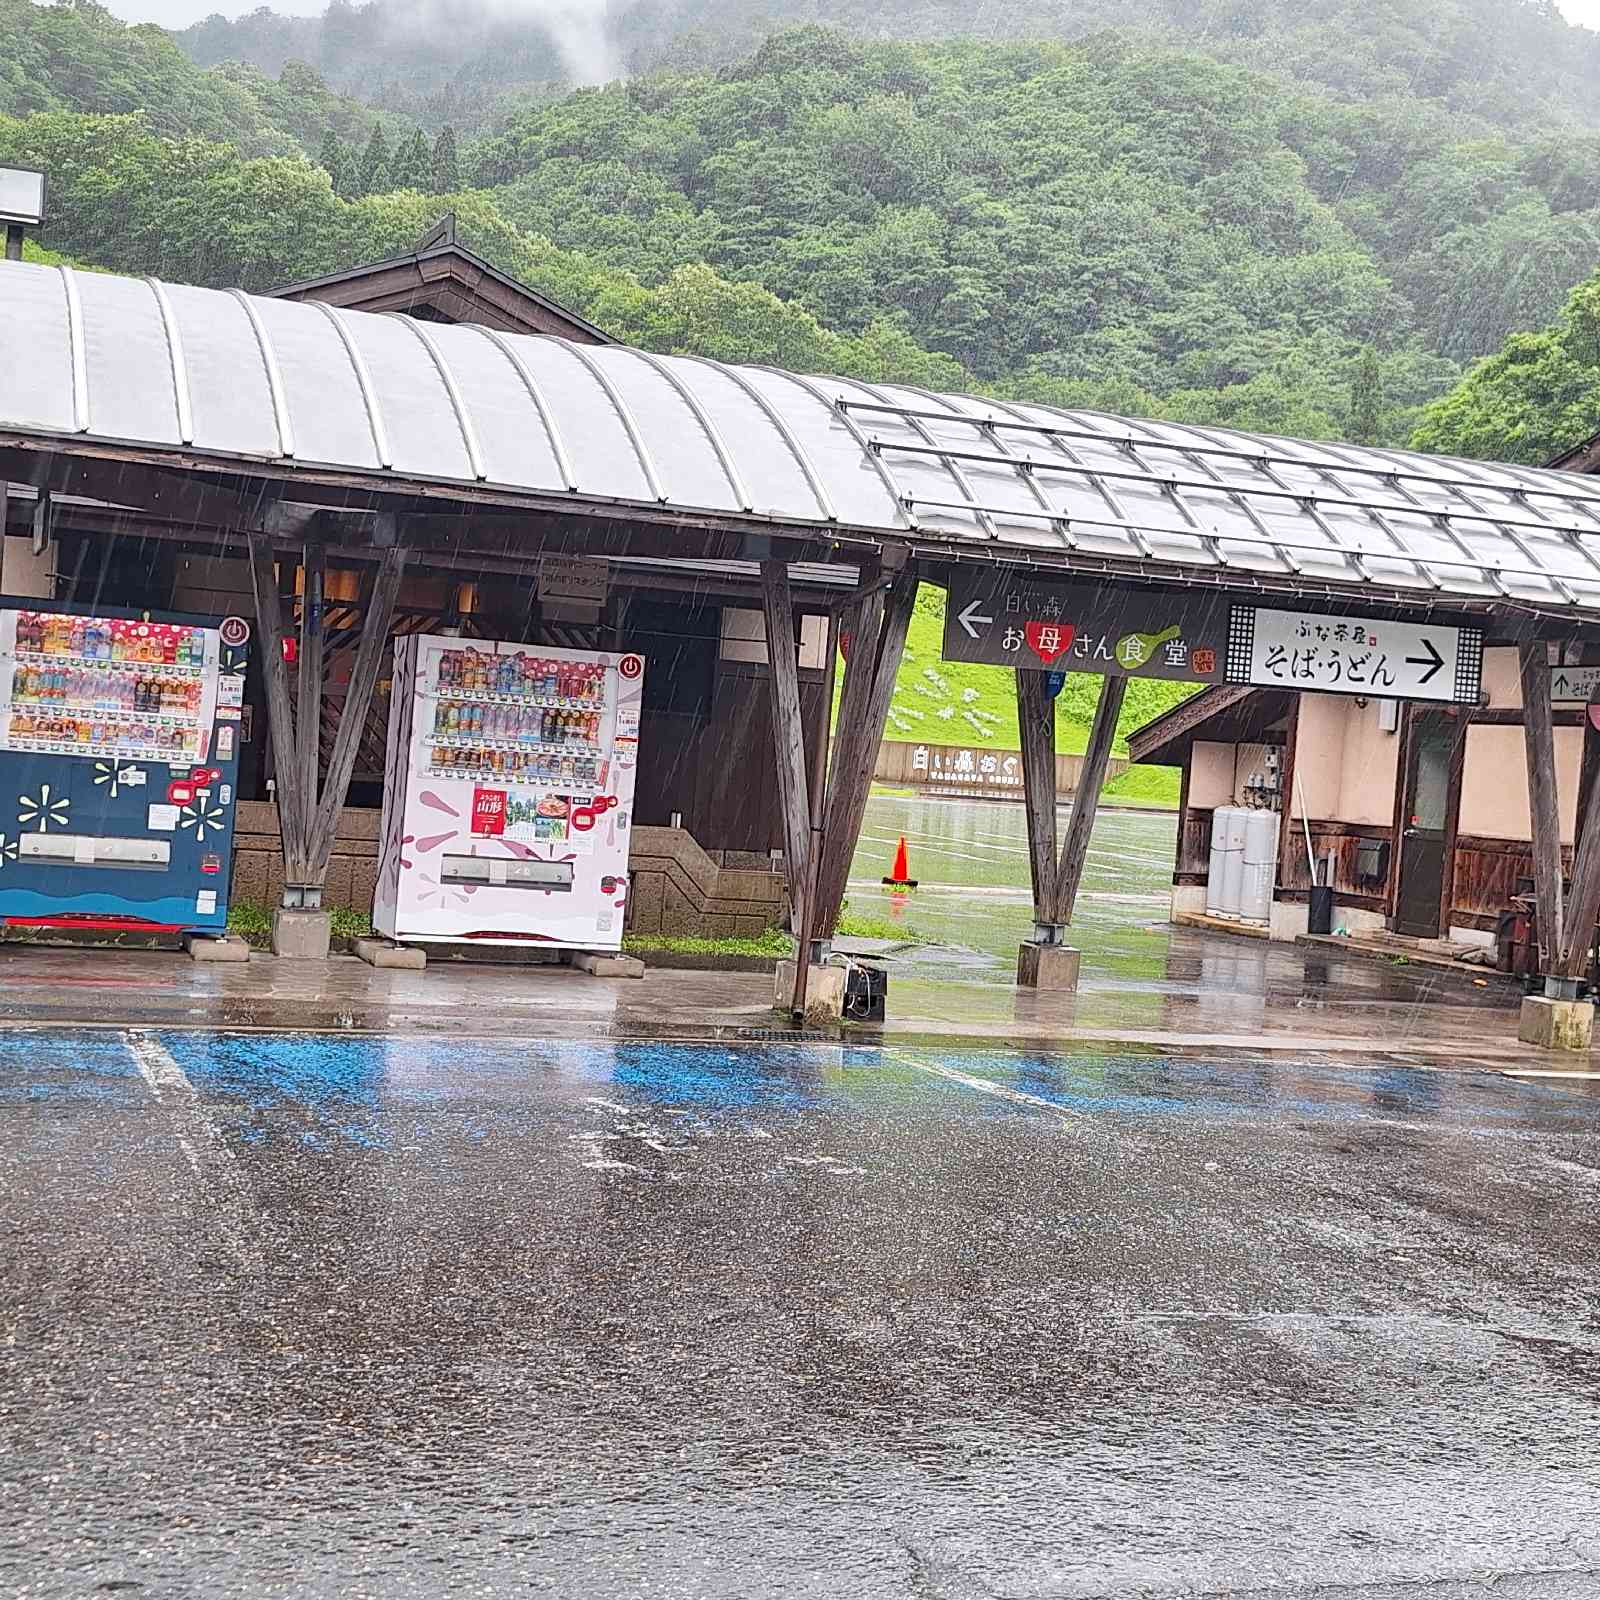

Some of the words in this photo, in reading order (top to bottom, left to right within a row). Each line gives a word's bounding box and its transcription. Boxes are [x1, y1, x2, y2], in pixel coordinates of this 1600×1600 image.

[1006, 591, 1063, 617] 白い森
[1295, 620, 1367, 645] ぶな茶屋
[1002, 625, 1188, 667] お母さん食堂
